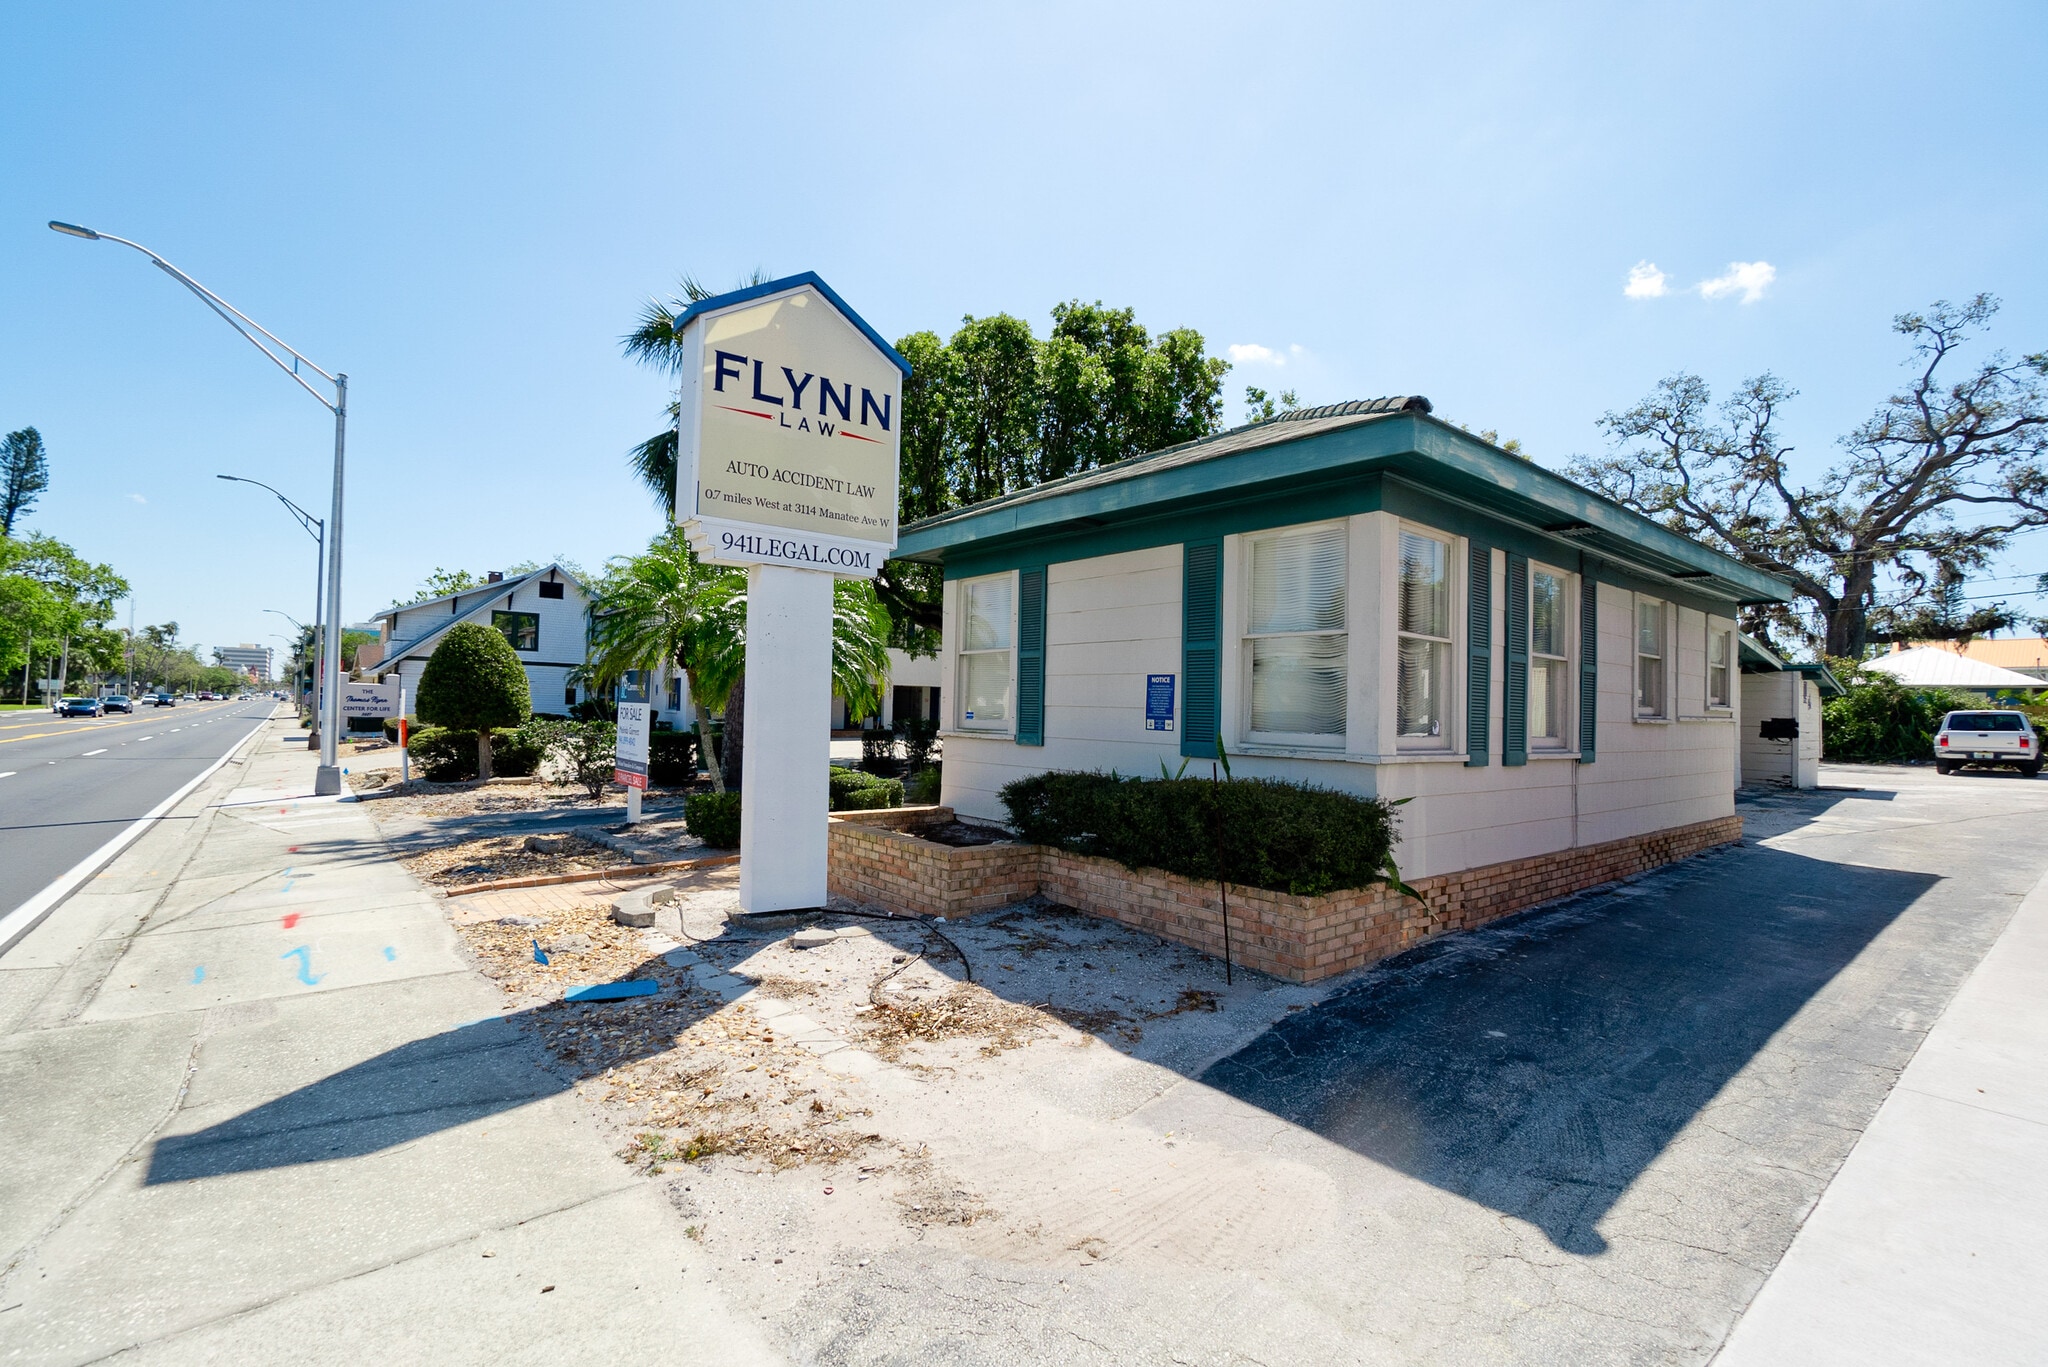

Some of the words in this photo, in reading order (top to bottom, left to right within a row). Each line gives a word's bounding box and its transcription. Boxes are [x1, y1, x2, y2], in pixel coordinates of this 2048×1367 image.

[713, 350, 892, 432] FLYNN
[780, 412, 836, 438] LAW
[726, 460, 769, 479] AUTO
[772, 469, 844, 493] ACCIDENT
[847, 482, 876, 499] LAW
[723, 492, 752, 506] miles
[755, 496, 780, 511] West
[783, 503, 793, 513] at
[795, 503, 817, 516] 3114
[819, 507, 859, 524] Manatee
[861, 515, 878, 526] Ave
[879, 518, 890, 528] W
[721, 532, 872, 570] 941LEGAL.COM
[346, 695, 370, 703] Thomas
[620, 707, 629, 720] FOR
[629, 707, 642, 722] SALE
[632, 775, 643, 787] SALE
